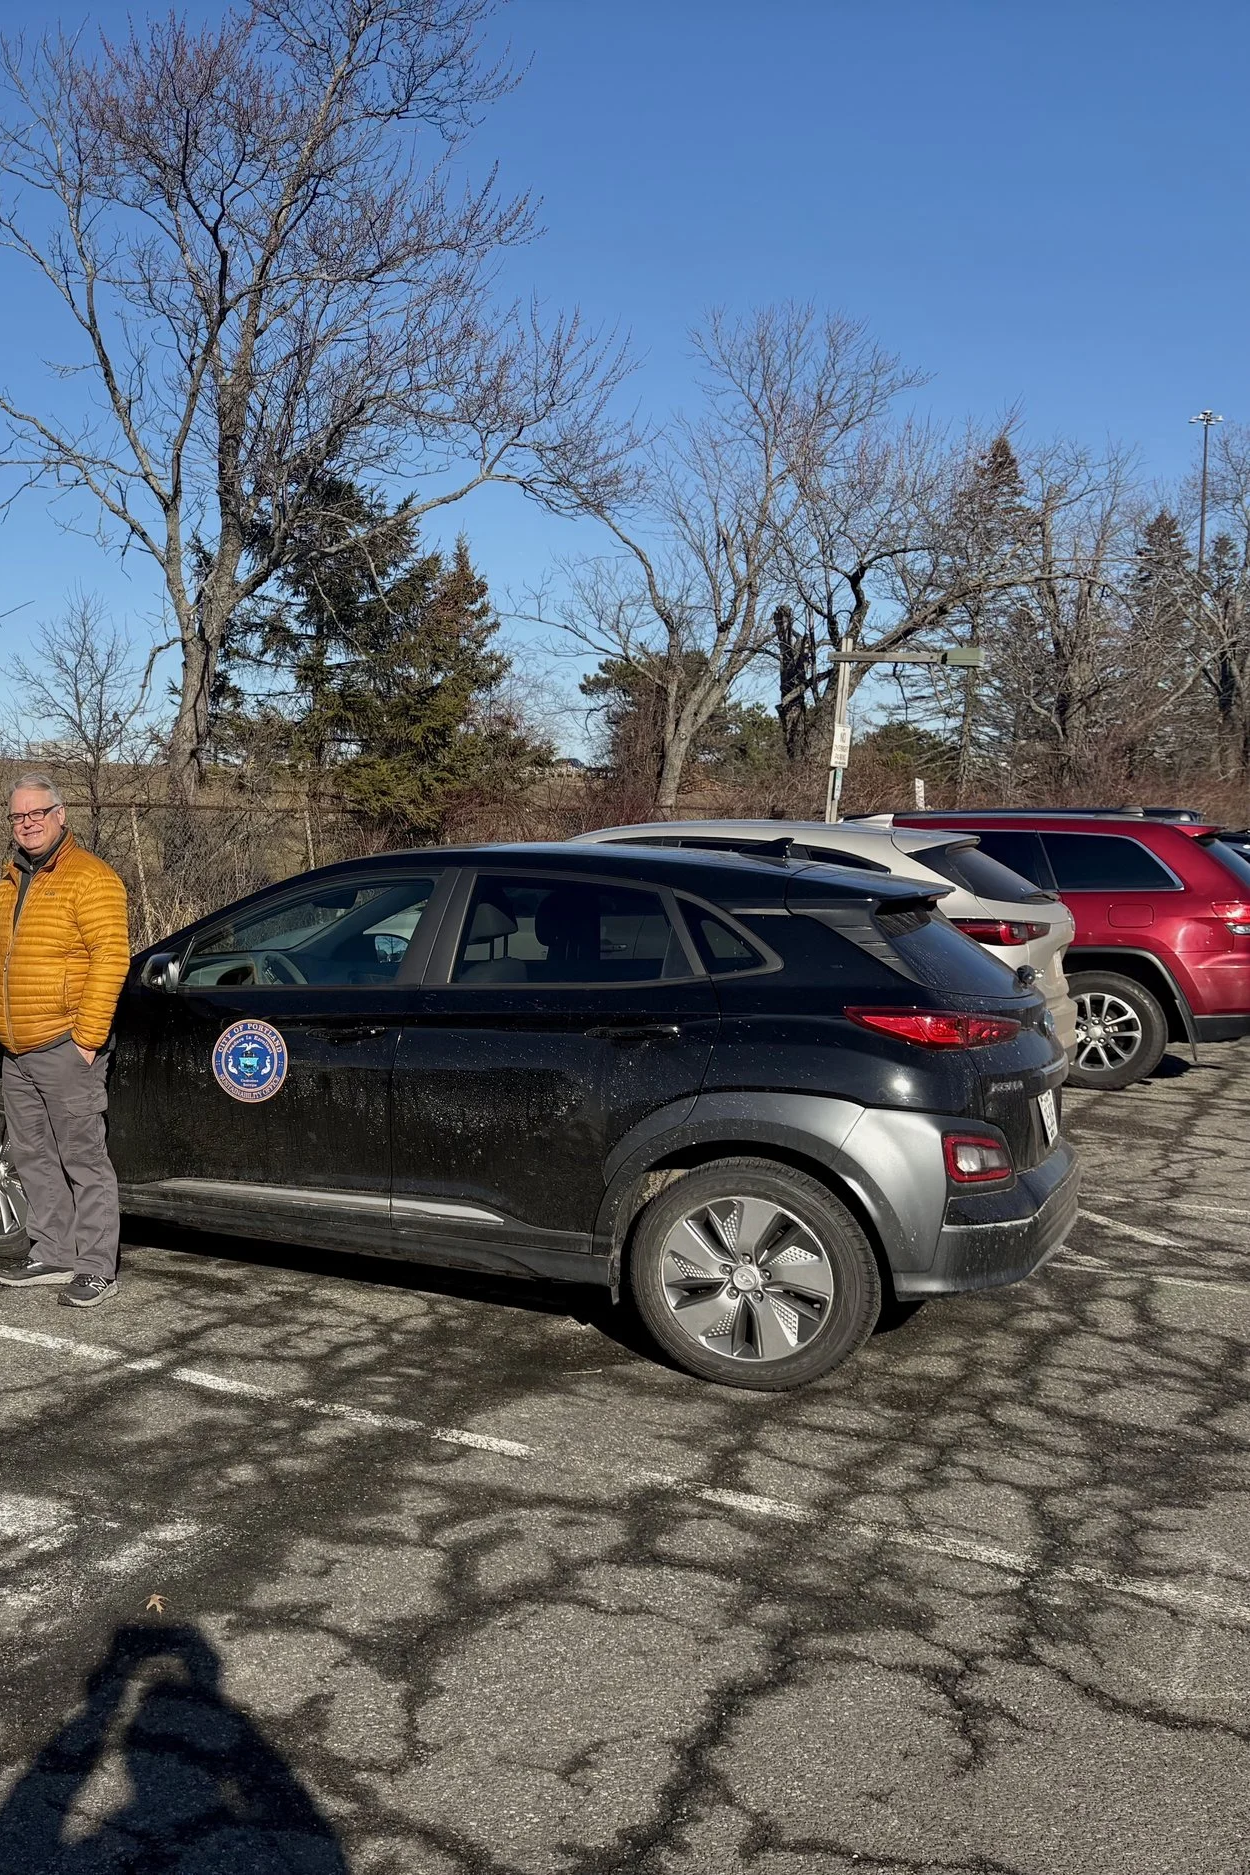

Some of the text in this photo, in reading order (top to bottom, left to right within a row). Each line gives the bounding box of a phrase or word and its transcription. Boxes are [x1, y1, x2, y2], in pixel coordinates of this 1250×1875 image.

[218, 1024, 283, 1053] CITY OF PORTLAND
